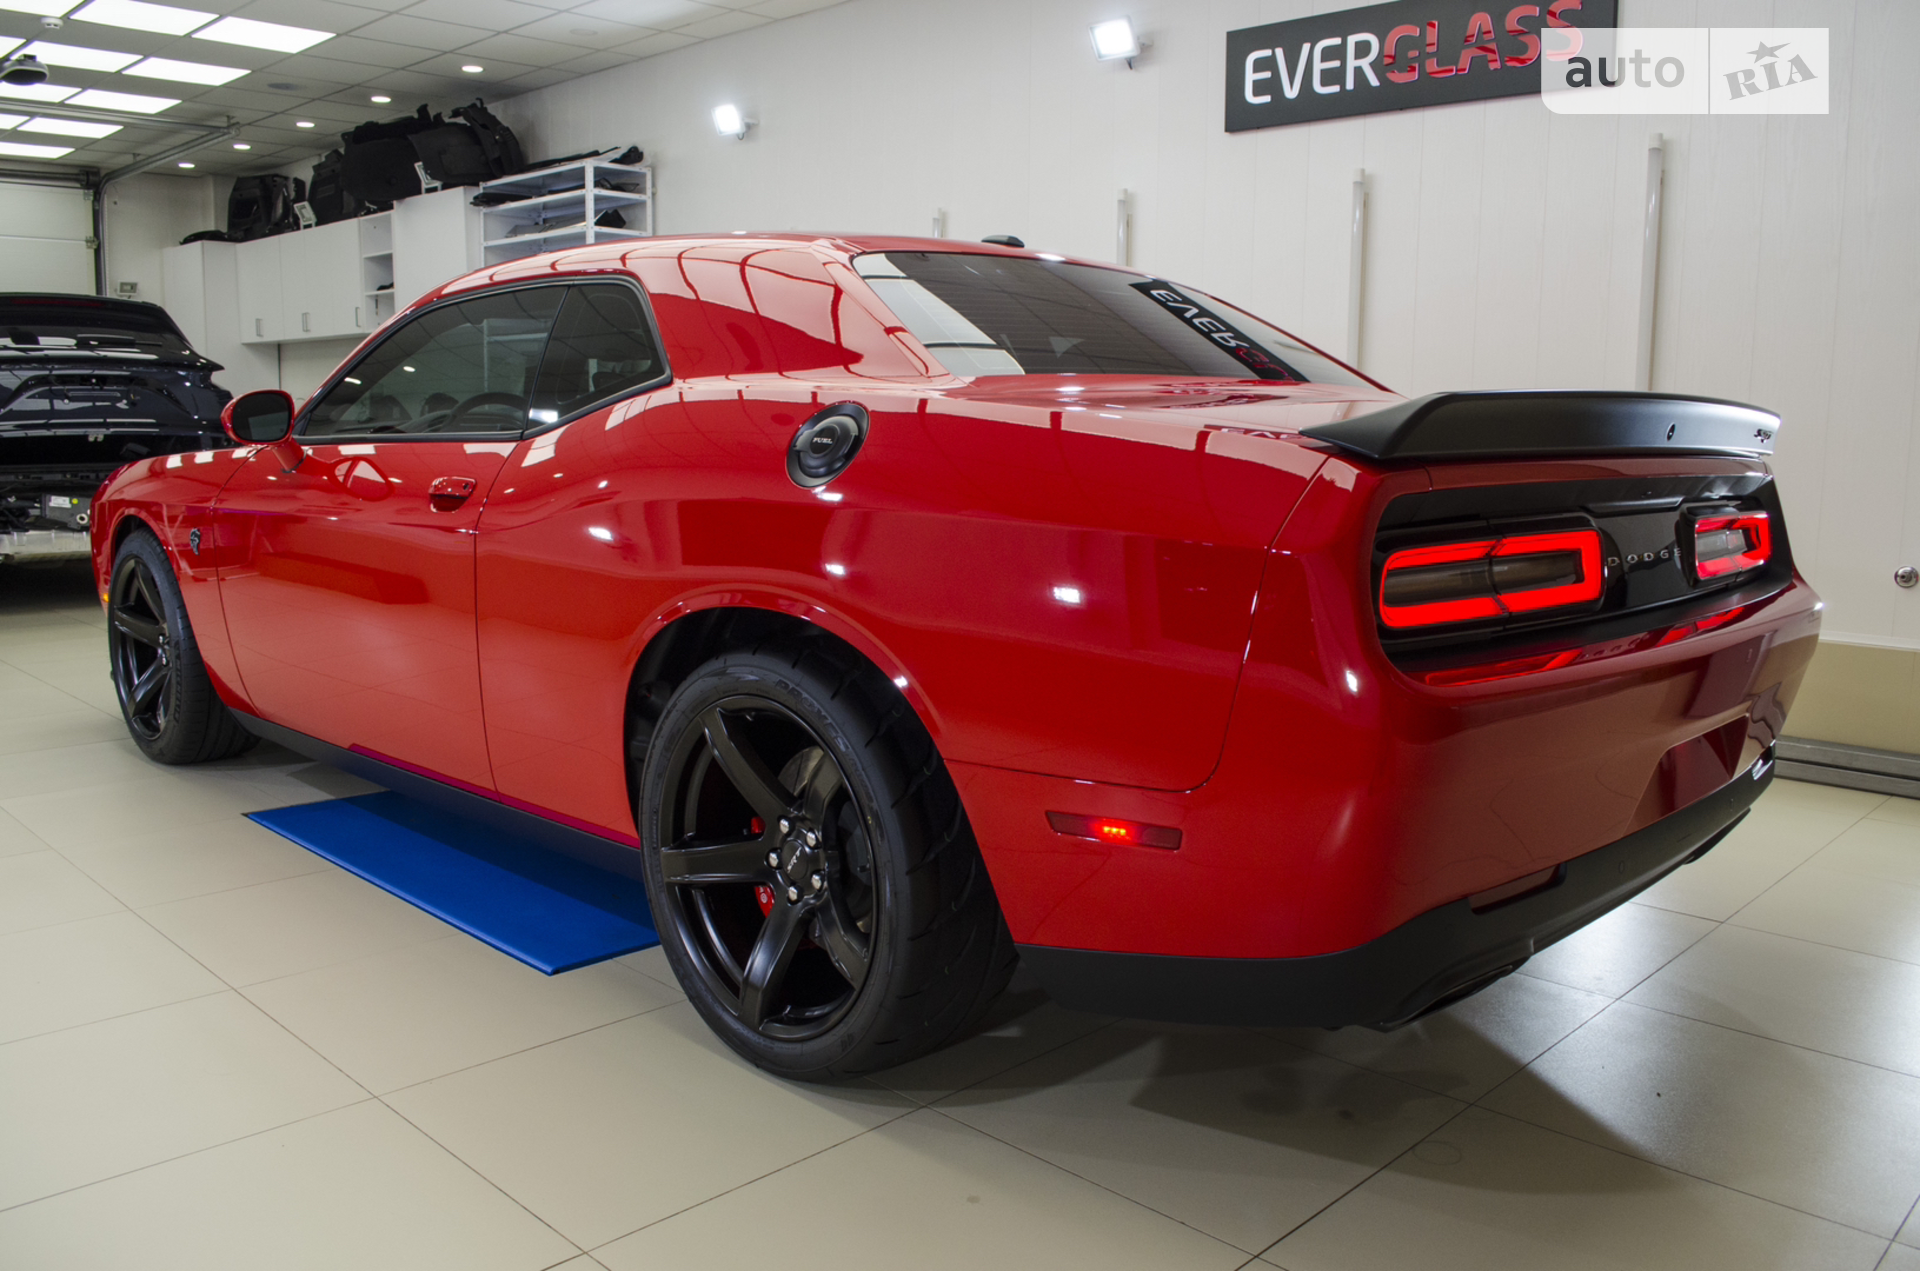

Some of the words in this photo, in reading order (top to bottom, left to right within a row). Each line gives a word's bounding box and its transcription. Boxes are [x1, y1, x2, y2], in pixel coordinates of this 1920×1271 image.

[1244, 0, 1584, 104] EVERGLASS
[812, 436, 833, 445] FUEL
[1607, 547, 1682, 567] DODGE
